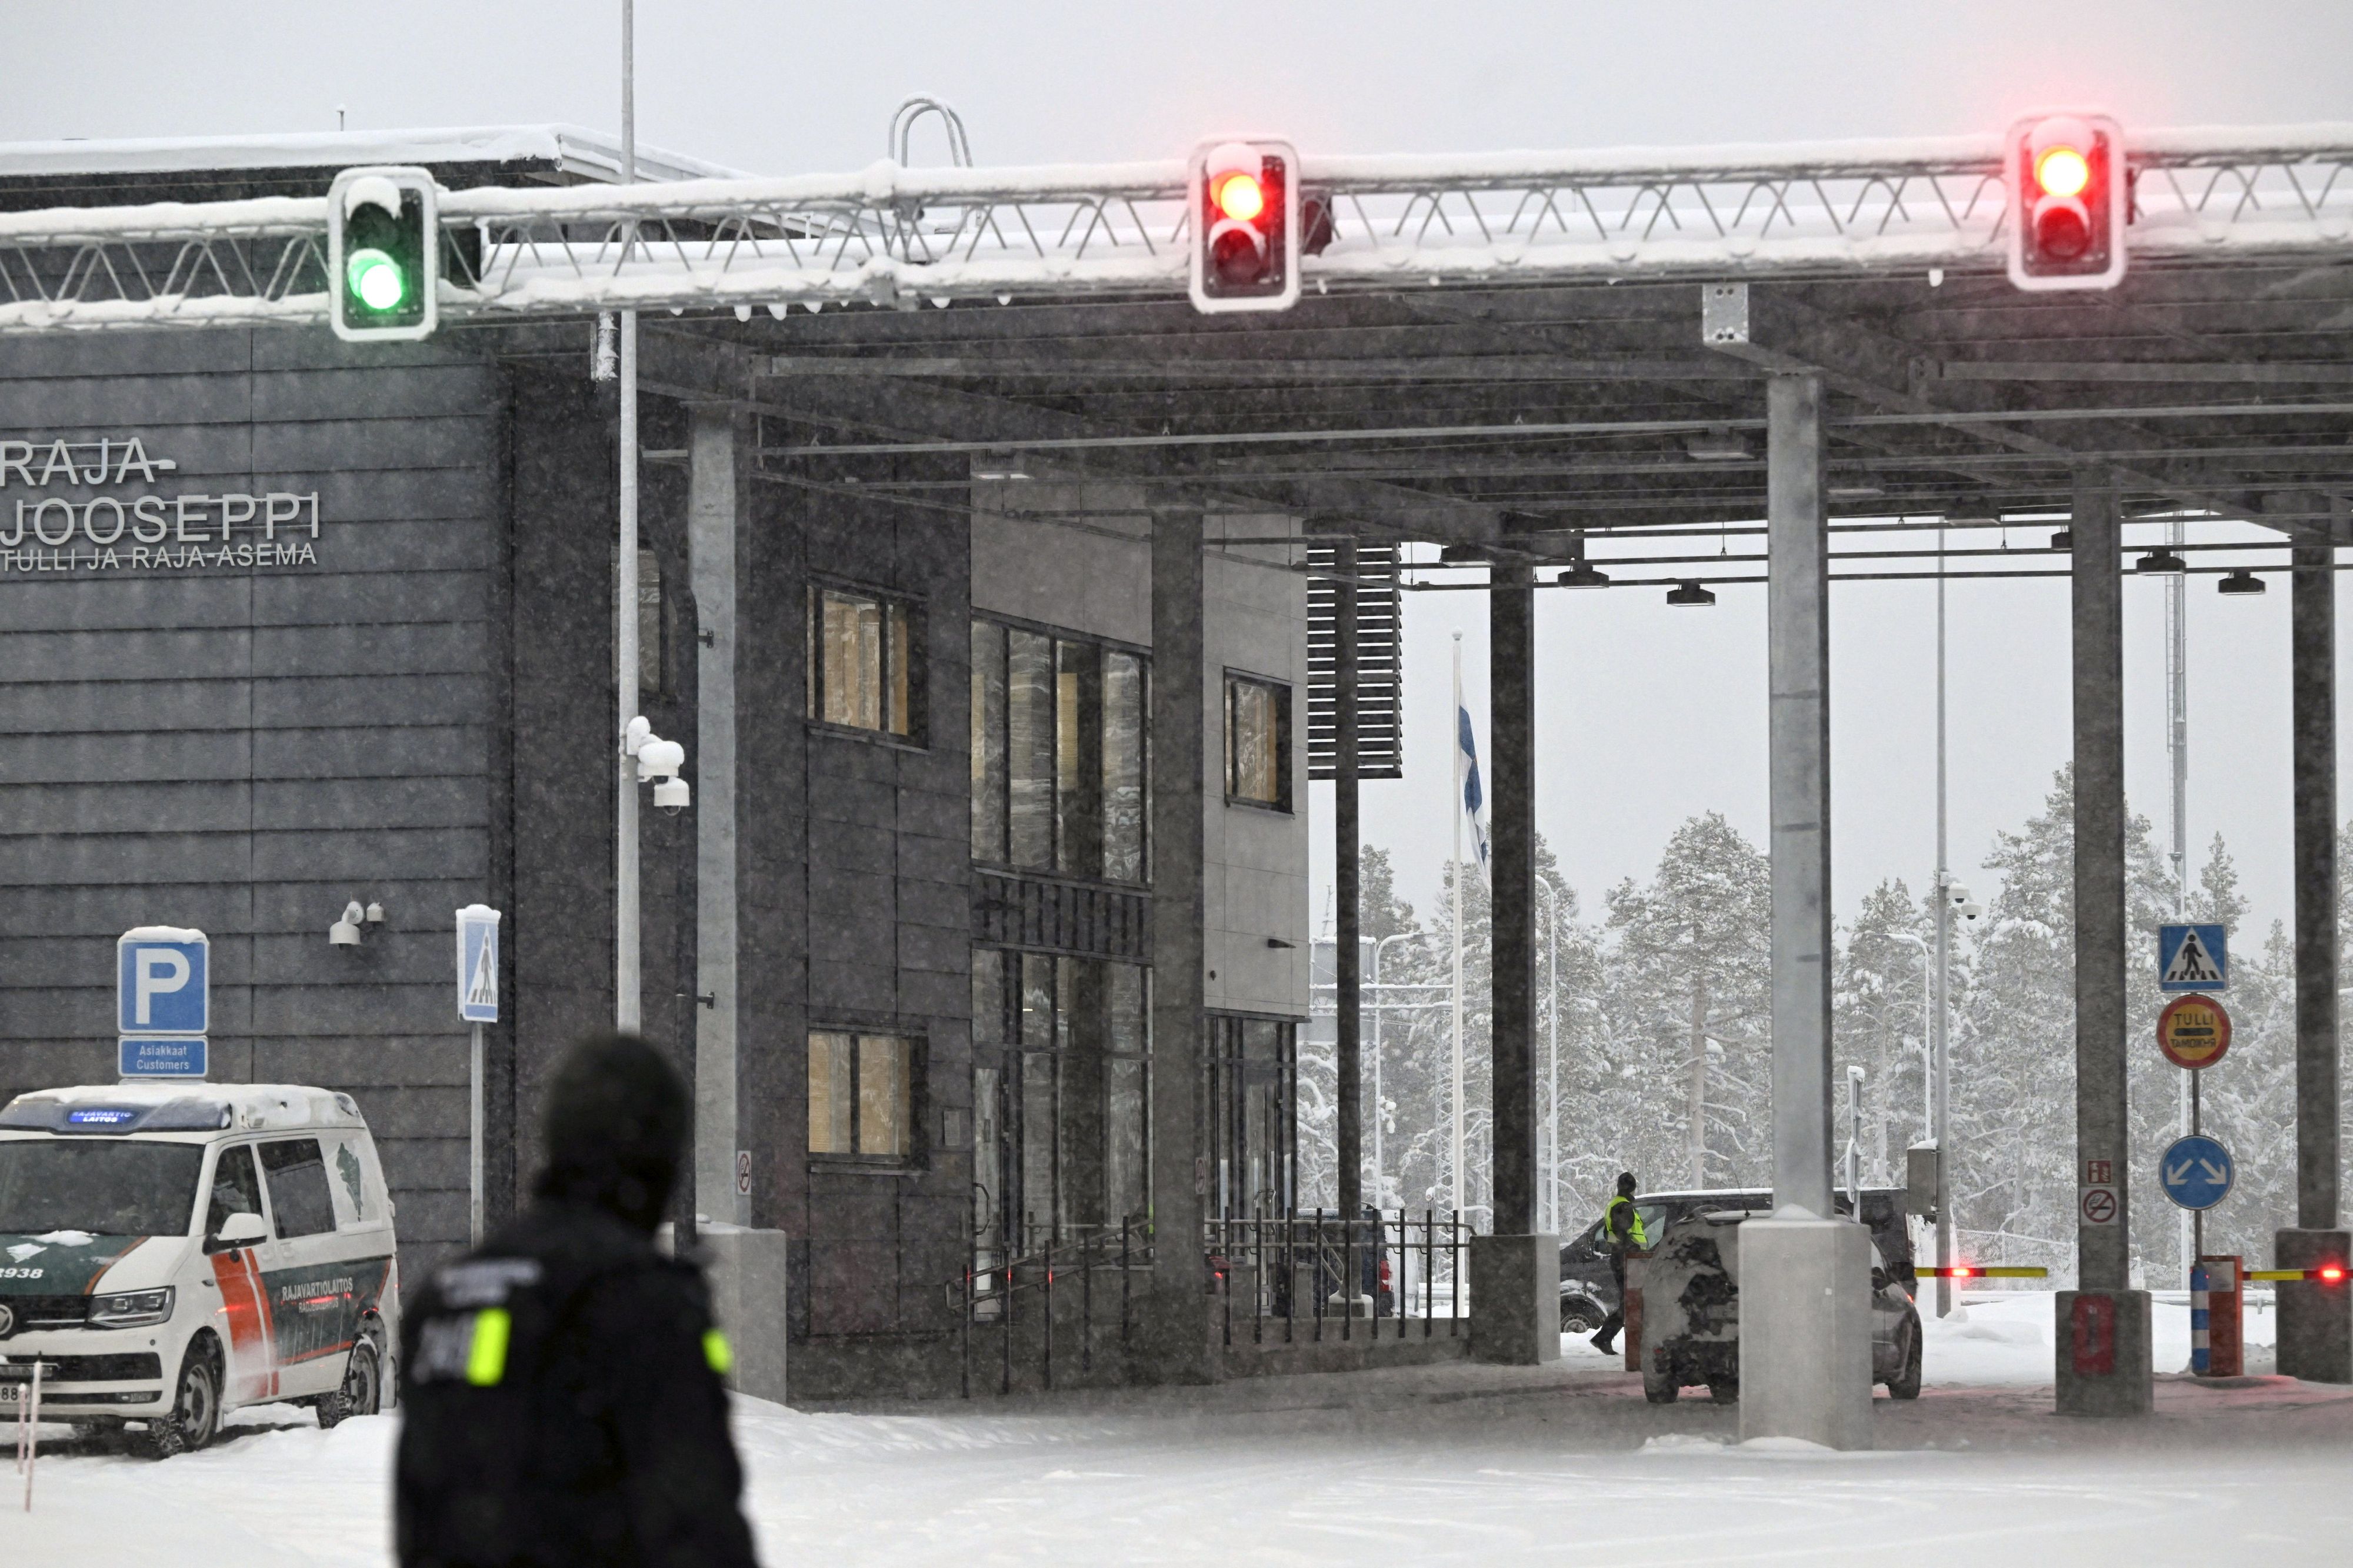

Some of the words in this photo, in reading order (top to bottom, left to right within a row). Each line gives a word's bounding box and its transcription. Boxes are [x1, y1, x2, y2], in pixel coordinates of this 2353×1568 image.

[0, 438, 176, 486] RAJA-
[0, 492, 318, 546] JOOSEPPI
[0, 548, 75, 572] TULLI
[87, 548, 119, 569] JA
[132, 543, 316, 569] RAJA-ASEMA
[136, 948, 190, 1025] P
[2174, 1013, 2214, 1025] TULLI
[139, 1046, 187, 1056] Asiakkaat
[136, 1059, 189, 1070] Customers
[282, 1276, 353, 1300] RAJAVARTIOLAITOS
[1, 1387, 28, 1400] 88
